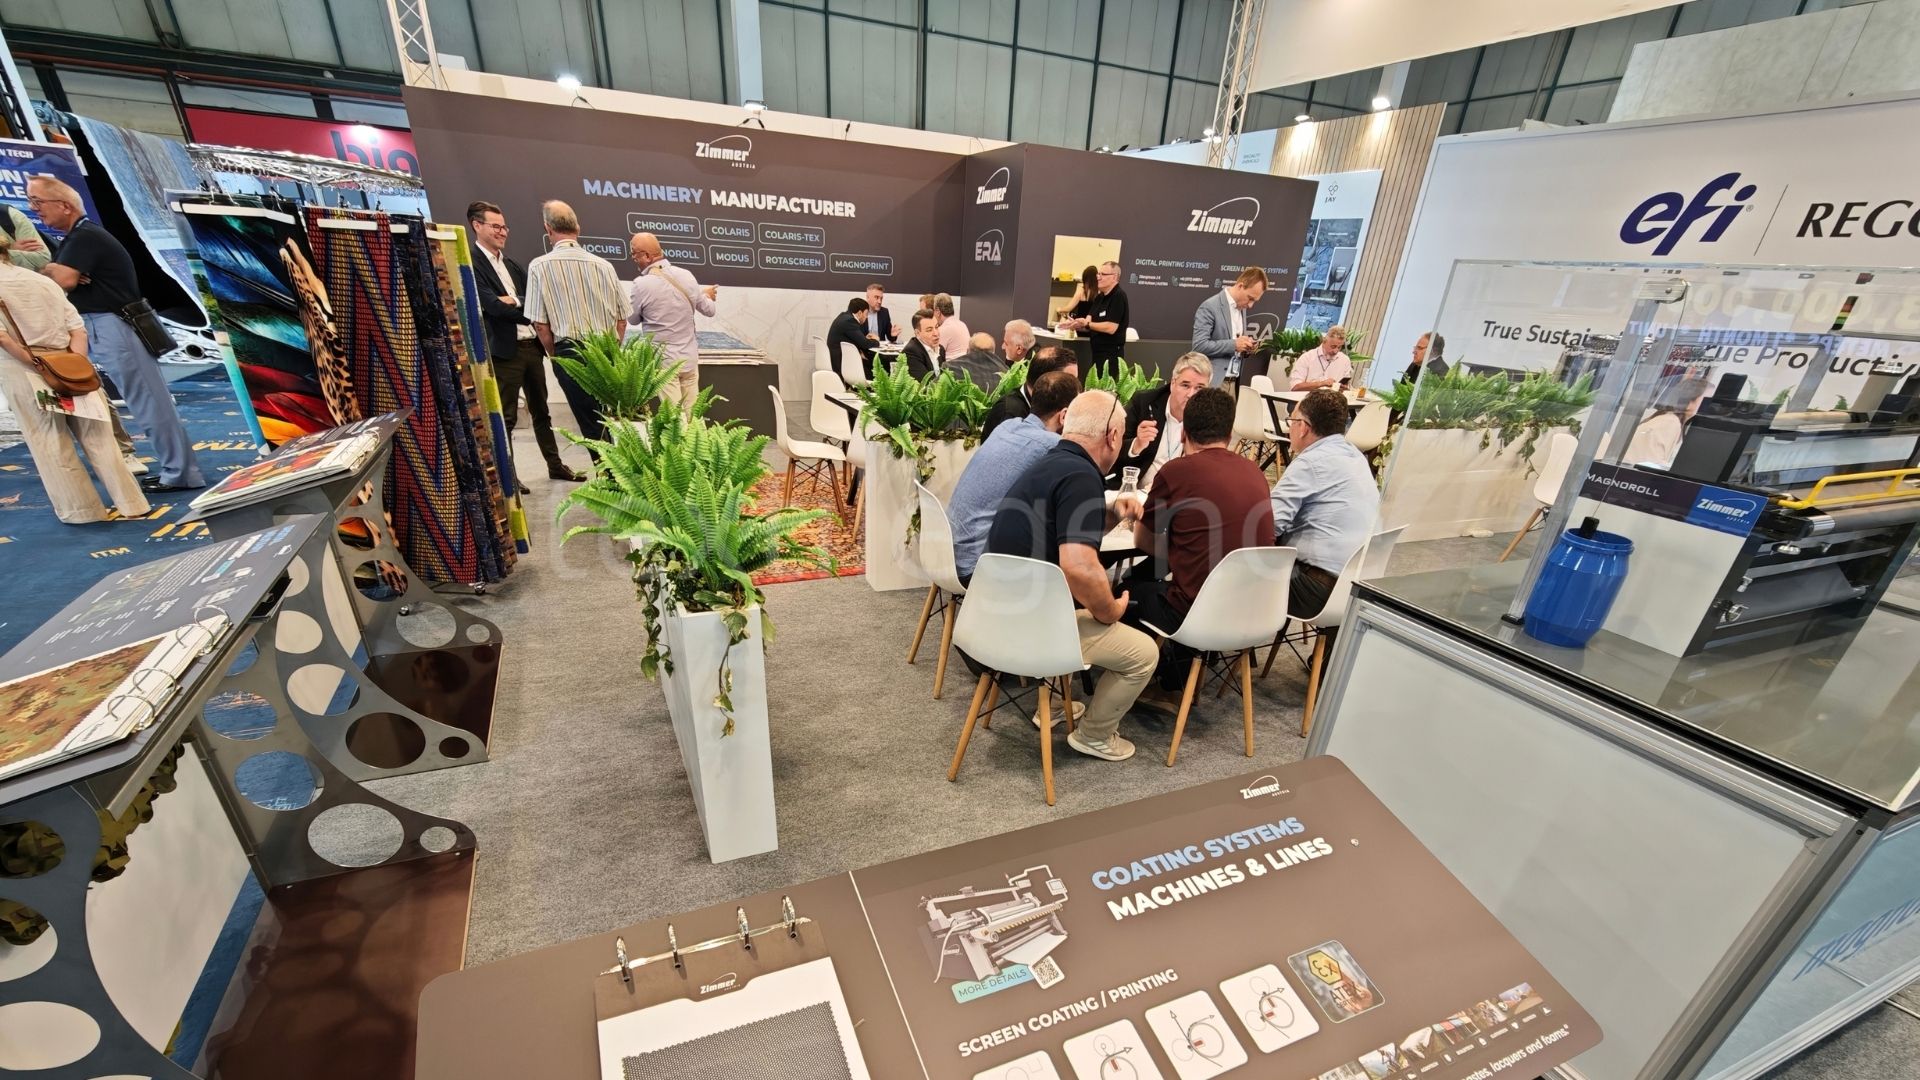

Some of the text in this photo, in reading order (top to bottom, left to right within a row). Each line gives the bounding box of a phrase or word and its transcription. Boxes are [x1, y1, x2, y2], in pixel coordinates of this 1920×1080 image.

[6, 149, 34, 159] TECH
[695, 142, 750, 161] Zimmer
[582, 178, 856, 218] MACHINERY MANUFACTURER
[976, 186, 1007, 205] Zimmer
[1187, 209, 1254, 236] Zimmer
[1620, 172, 1920, 256] efi REG
[634, 220, 695, 233] CHROMOJET
[711, 225, 750, 237] COLARIS
[765, 230, 820, 242] COLARIS-TEX
[1227, 238, 1256, 246] AUSTRIA
[662, 248, 700, 260] NOROLL
[716, 252, 750, 263] MODUS
[975, 240, 1002, 261] ERA
[765, 255, 821, 267] ROTASCREEN
[835, 259, 889, 271] MAGNOPRINT
[1135, 258, 1210, 270] DIGITAL PRINTING SYSTEMS
[1247, 322, 1273, 340] RA
[1483, 320, 1522, 340] True
[1526, 324, 1591, 347] Sustai
[1587, 473, 1660, 497] MAGNOROLL
[1696, 498, 1750, 517] Zimmer
[90, 546, 133, 560] ITM
[1240, 783, 1280, 799] Zimmer
[1091, 816, 1305, 890] COATING SYSTEMS
[1106, 837, 1334, 921] MACHINES & LINES
[700, 979, 736, 994] Zimmer
[958, 968, 1027, 998] MORE DETAILS
[958, 968, 1179, 1057] SCREEN COATING / PRINTING
[1461, 1067, 1494, 1080] astes,
[1489, 1048, 1527, 1073] lacquers
[1525, 1039, 1545, 1055] and
